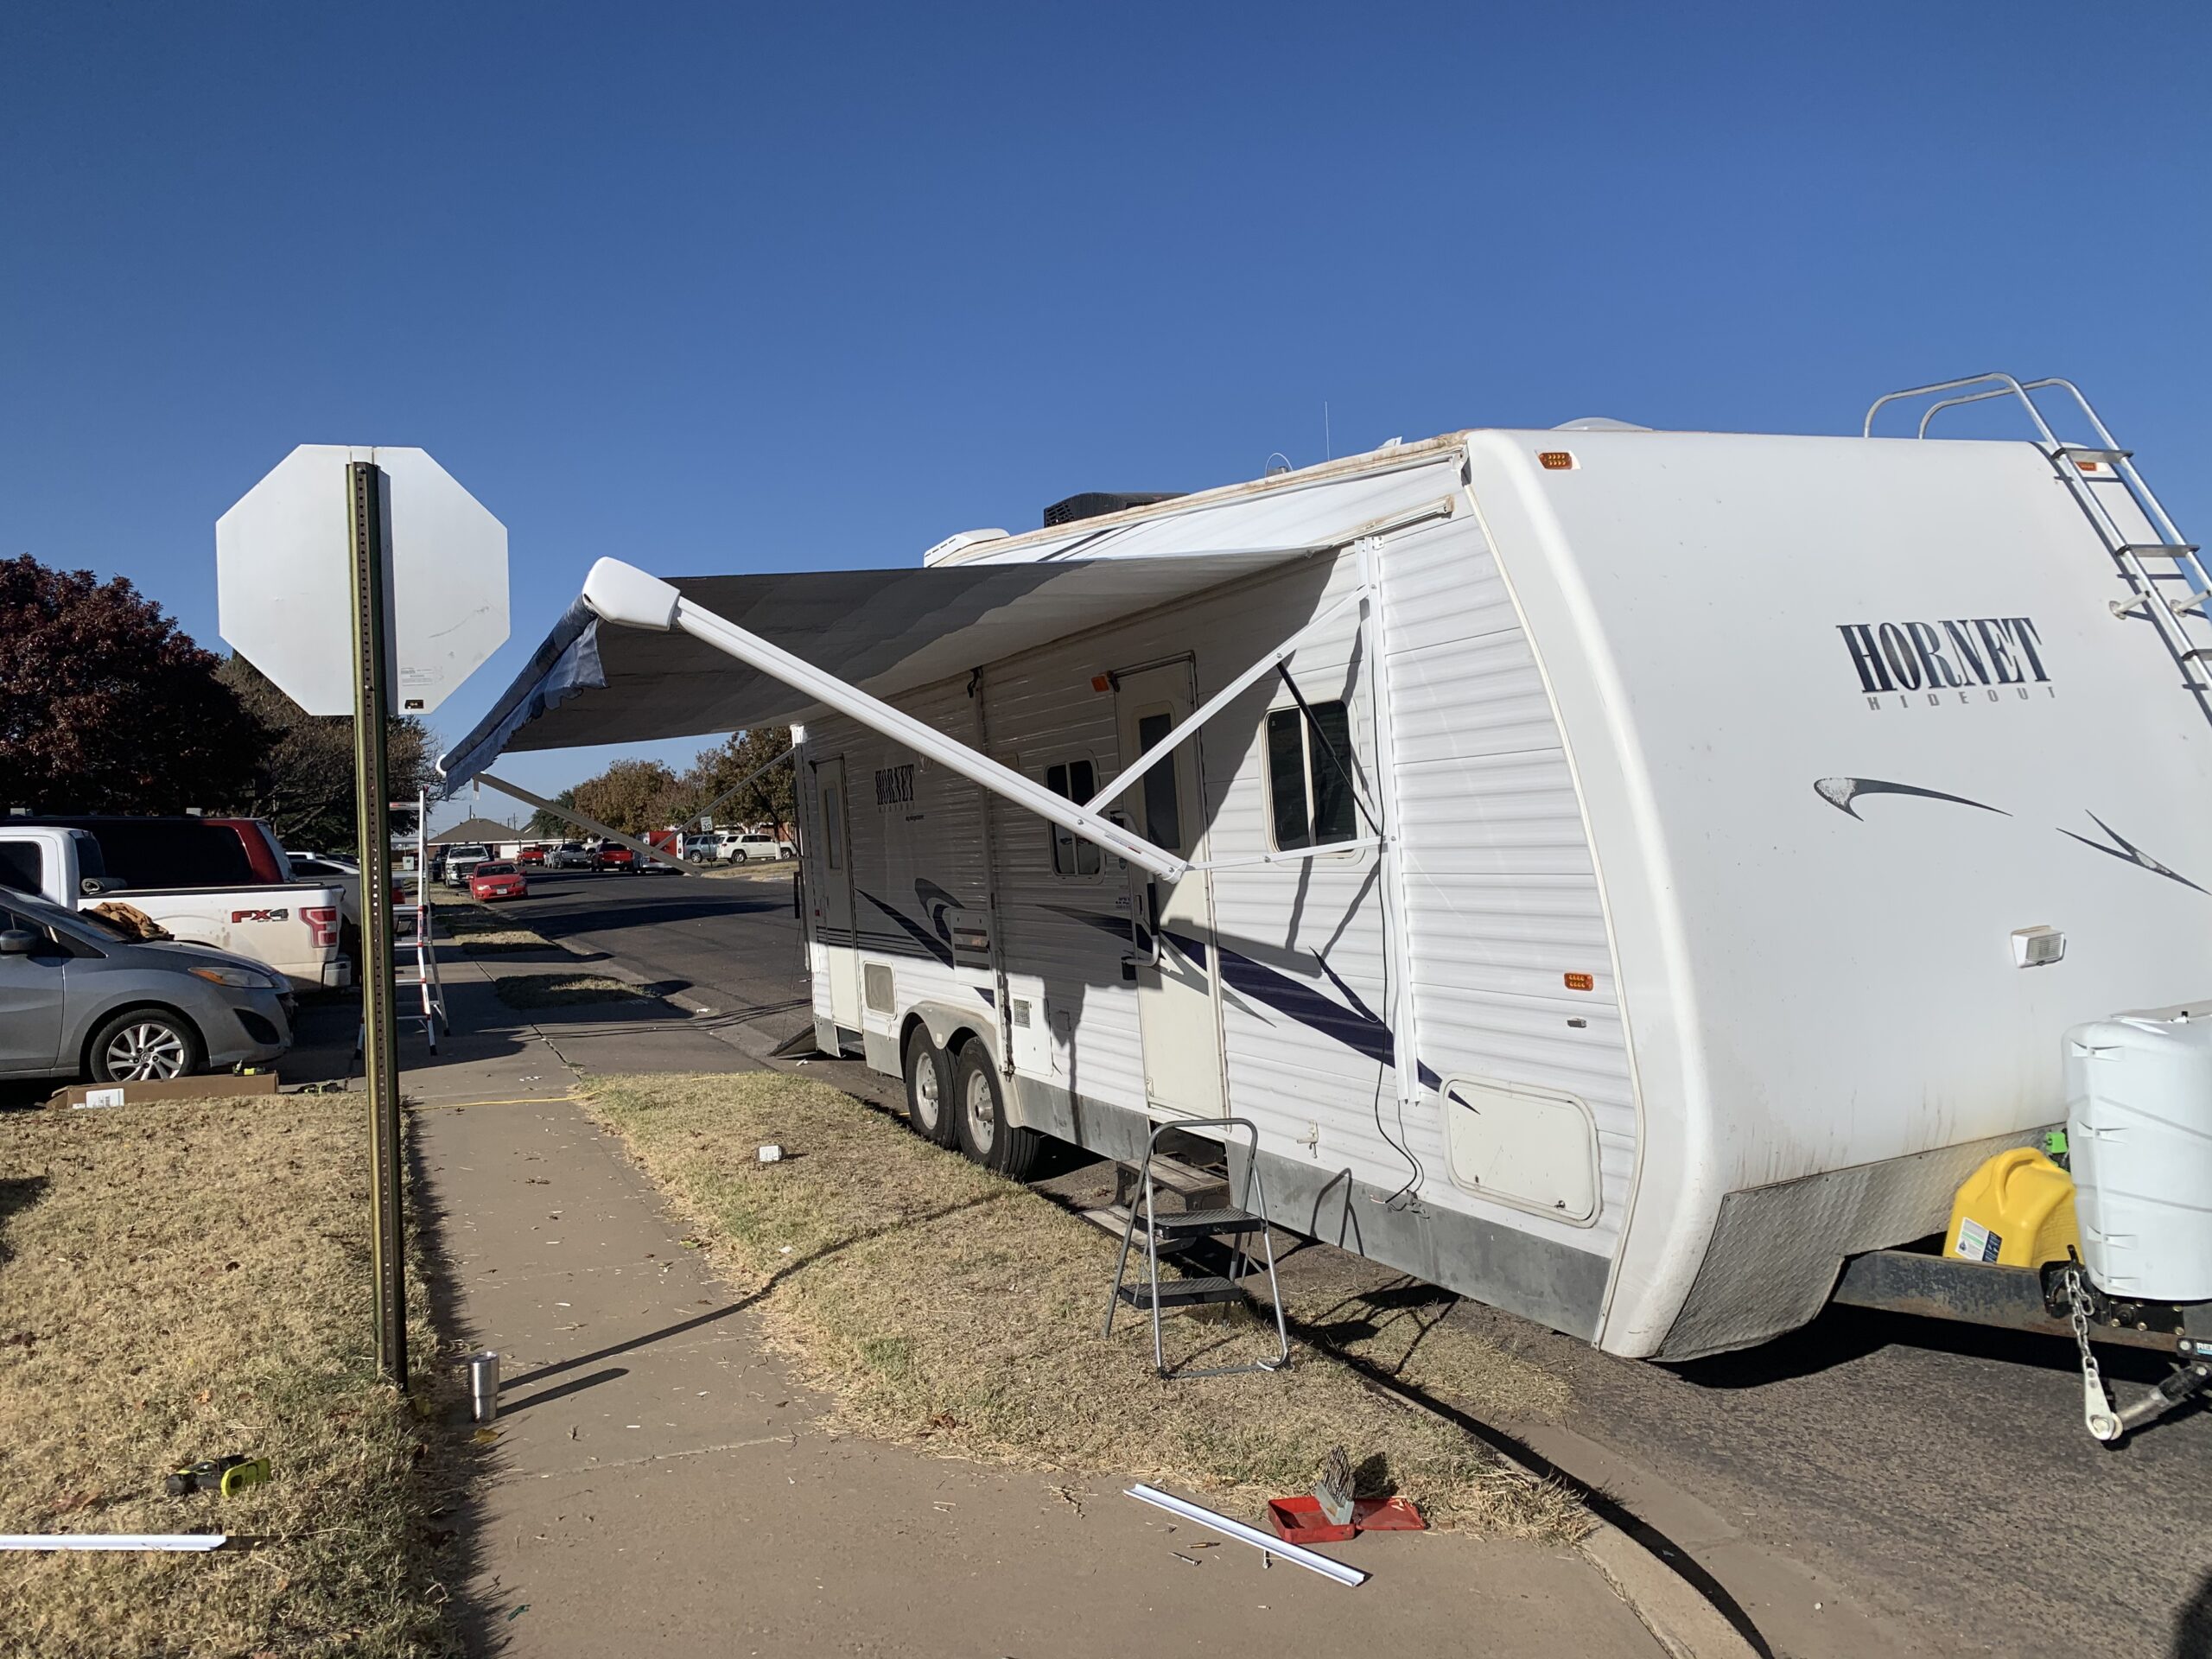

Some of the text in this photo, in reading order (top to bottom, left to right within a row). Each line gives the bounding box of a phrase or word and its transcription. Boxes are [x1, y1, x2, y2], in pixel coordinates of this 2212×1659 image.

[1835, 617, 2052, 694] HORNET
[1866, 686, 2056, 711] HIDEOUT
[874, 763, 916, 805] HORNET
[232, 908, 289, 923] FX4
